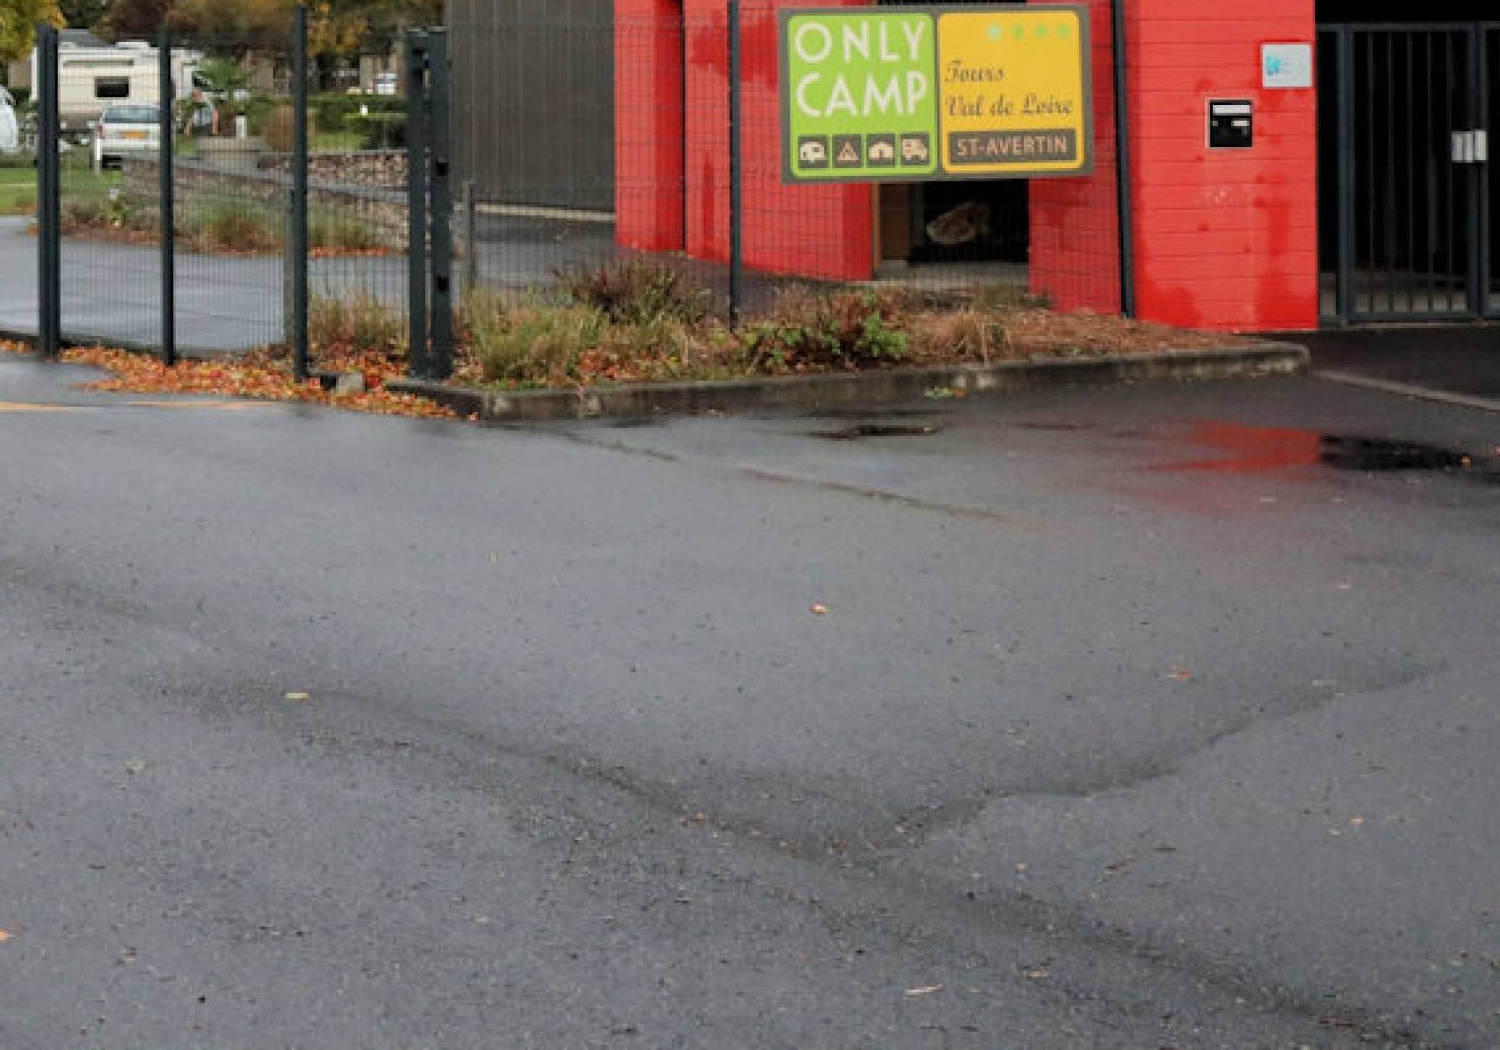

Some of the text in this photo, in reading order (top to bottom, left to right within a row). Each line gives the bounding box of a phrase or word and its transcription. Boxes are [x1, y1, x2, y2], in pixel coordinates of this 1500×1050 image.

[795, 20, 925, 64] ONLY
[944, 59, 1006, 83] Tours
[796, 70, 928, 119] CAMP
[944, 92, 1074, 118] Val de Loire
